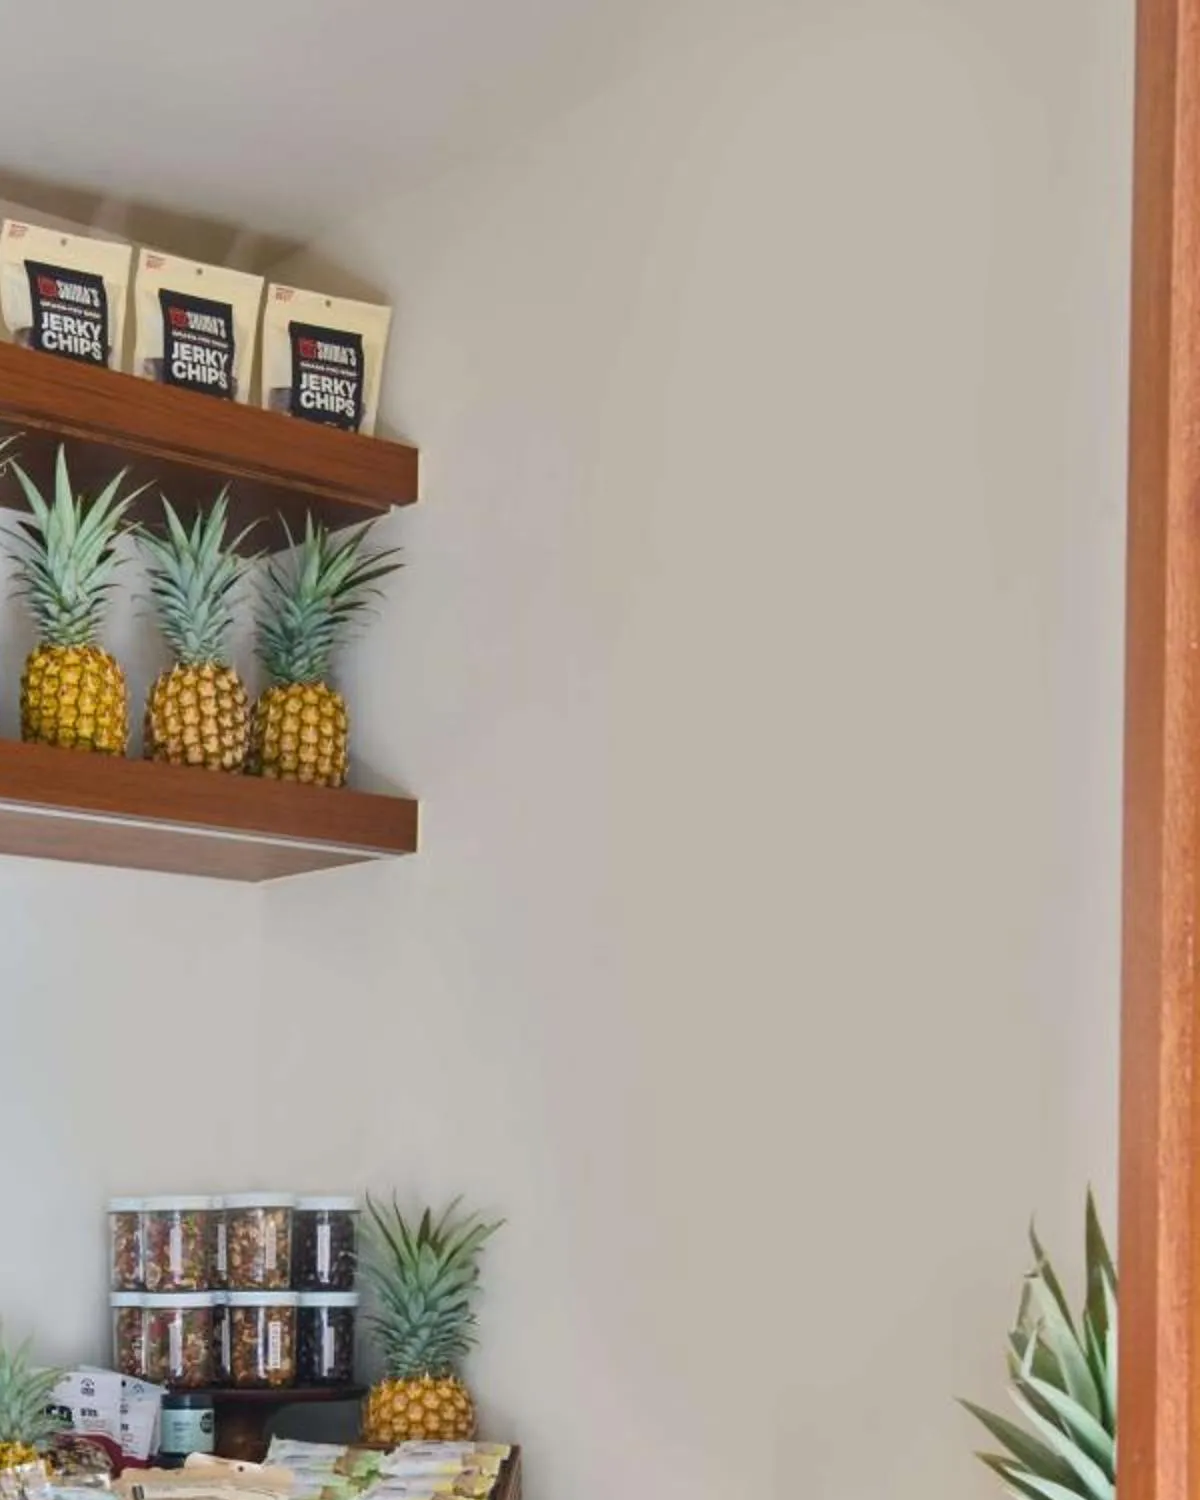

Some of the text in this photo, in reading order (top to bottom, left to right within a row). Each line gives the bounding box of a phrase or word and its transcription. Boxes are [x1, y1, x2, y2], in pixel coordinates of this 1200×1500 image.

[41, 311, 103, 340] JERKY
[41, 331, 102, 360] CHIPS
[171, 341, 229, 366] JERKY
[171, 360, 229, 389] CHIPS
[299, 372, 358, 396] JERKY
[299, 391, 356, 418] CHIPS
